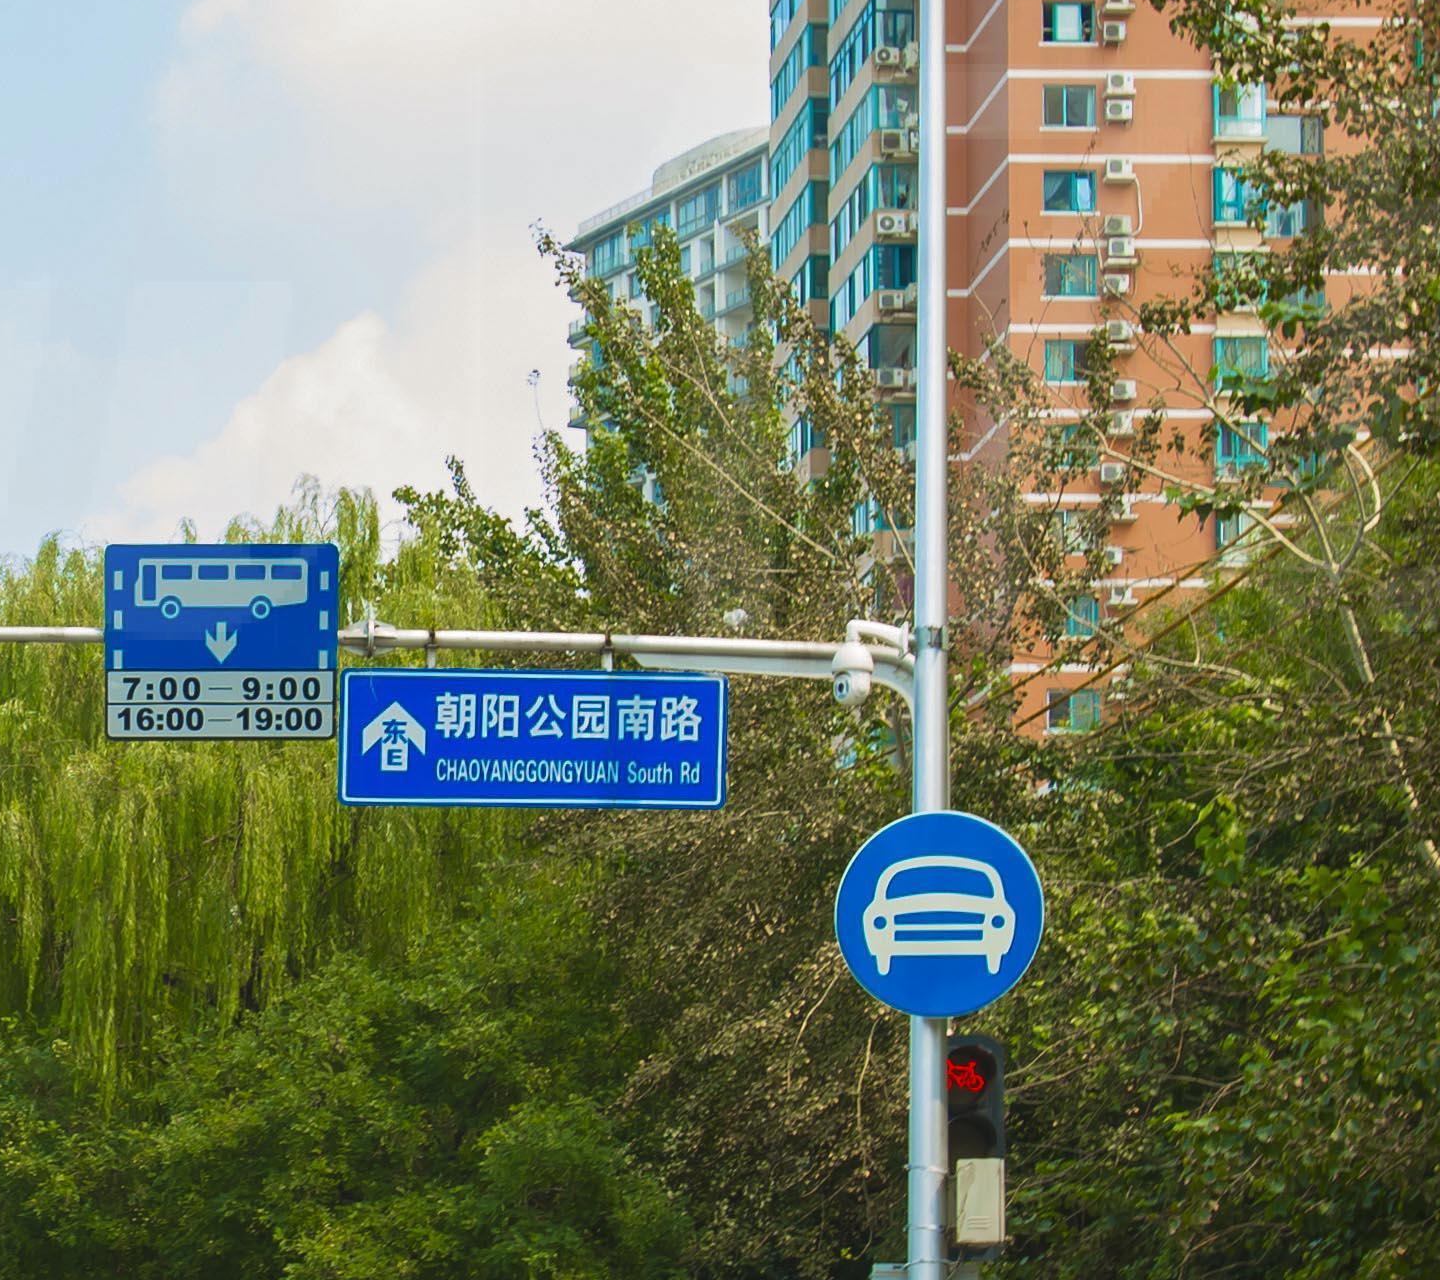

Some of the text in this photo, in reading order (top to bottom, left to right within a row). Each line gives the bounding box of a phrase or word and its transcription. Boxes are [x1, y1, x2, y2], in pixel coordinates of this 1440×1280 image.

[435, 691, 702, 742] 朝阳公园南路
[382, 719, 408, 744] 东
[387, 749, 402, 766] E
[436, 758, 701, 785] CHAOYANGGONGYUAN South Rd
